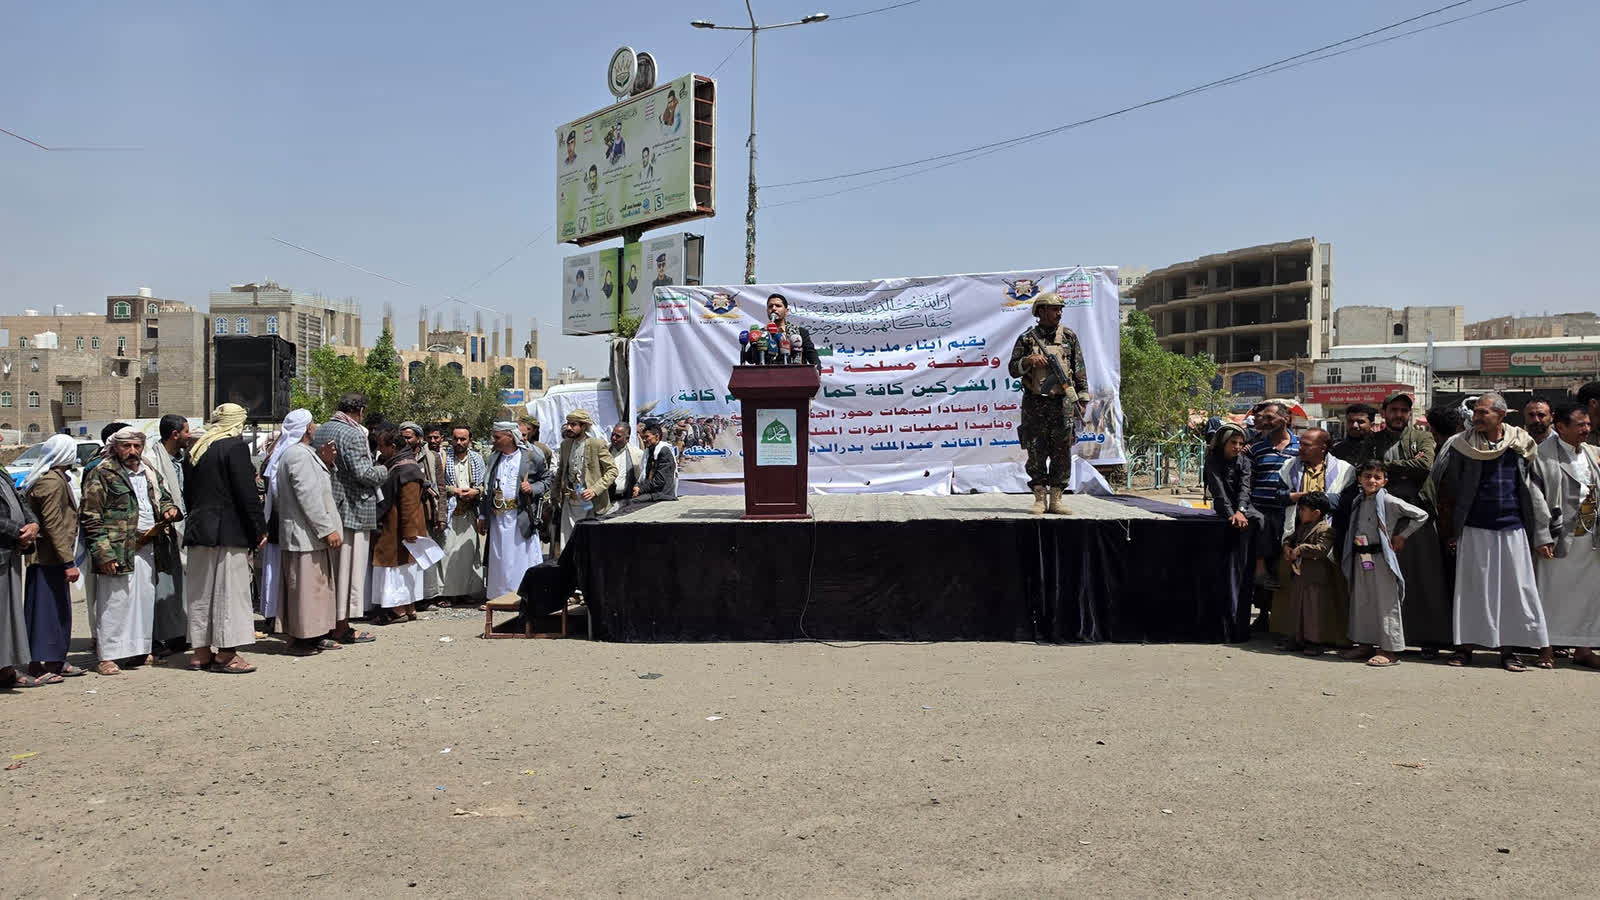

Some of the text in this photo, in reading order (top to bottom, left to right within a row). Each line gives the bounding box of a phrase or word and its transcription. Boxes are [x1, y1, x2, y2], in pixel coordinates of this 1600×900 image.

[920, 293, 939, 309] الله
[837, 342, 900, 357] مديرية
[905, 335, 941, 353] أبناء
[948, 336, 986, 350] يقيم
[843, 360, 917, 373] مسلحة
[927, 354, 1000, 368] وقفة
[823, 384, 857, 398] كما
[865, 382, 904, 396] كافة
[911, 378, 996, 397] المشركين
[880, 405, 931, 417] لجبهات
[993, 402, 1022, 411] عما
[840, 409, 873, 419] محور
[809, 417, 1012, 436] وتأييدا لعمليات القوات المسل
[809, 442, 864, 455] بدرالدي
[941, 437, 982, 448] القائد
[989, 438, 1021, 448] سيد
